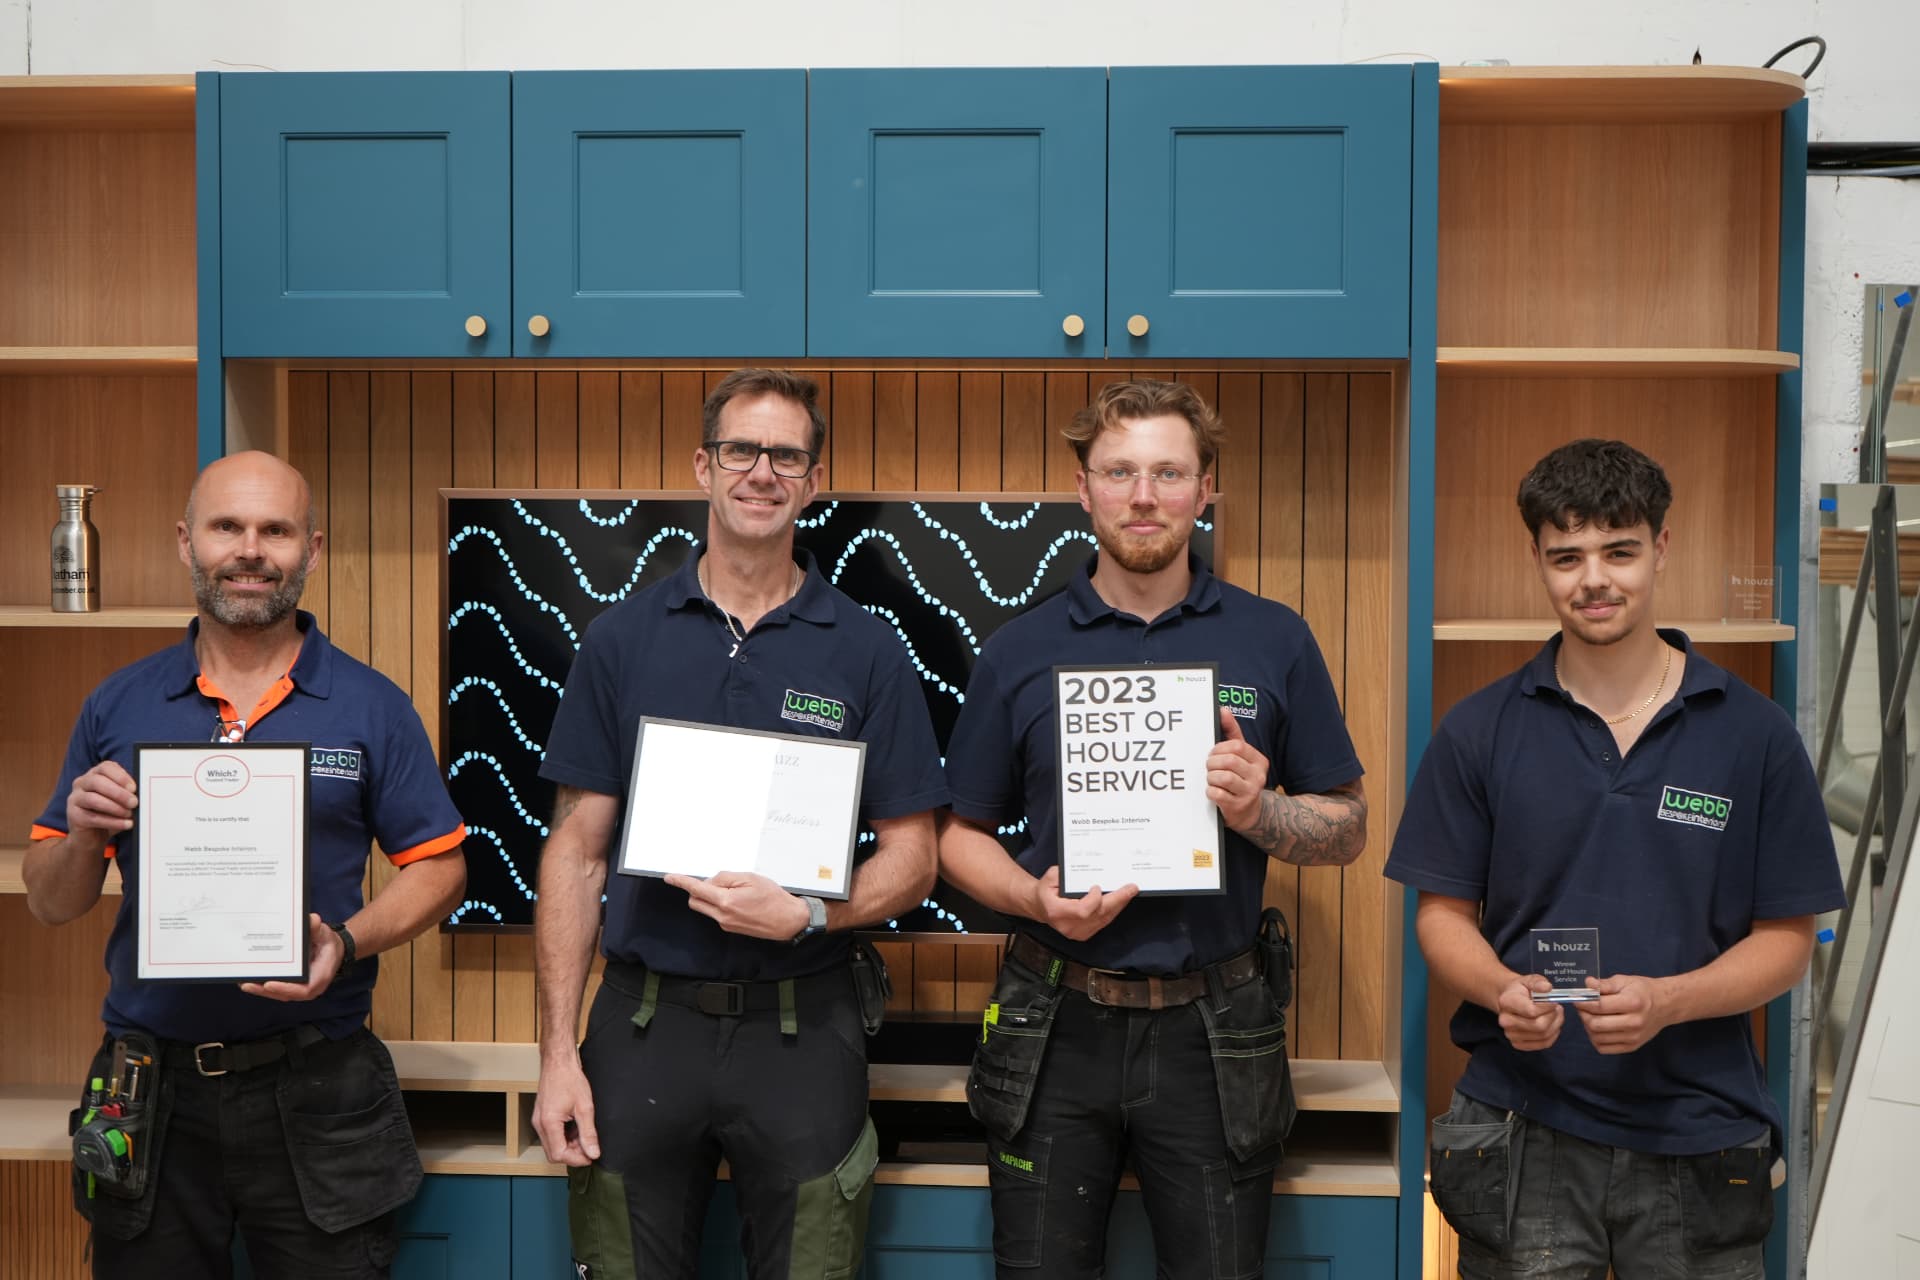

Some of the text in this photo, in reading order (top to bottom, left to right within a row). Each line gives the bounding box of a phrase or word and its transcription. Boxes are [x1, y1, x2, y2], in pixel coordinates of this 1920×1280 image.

[1064, 676, 1157, 705] 2023
[1218, 688, 1256, 707] ebb
[787, 695, 842, 720] webb
[1066, 710, 1184, 734] BEST OF
[1067, 740, 1167, 763] HOUZZ
[207, 769, 238, 777] Which?
[1067, 769, 1185, 793] SERVICE
[1665, 791, 1728, 818] webb
[1092, 818, 1120, 826] Bespoke
[1553, 942, 1591, 951] houzz
[1005, 1154, 1034, 1172] APACHE
